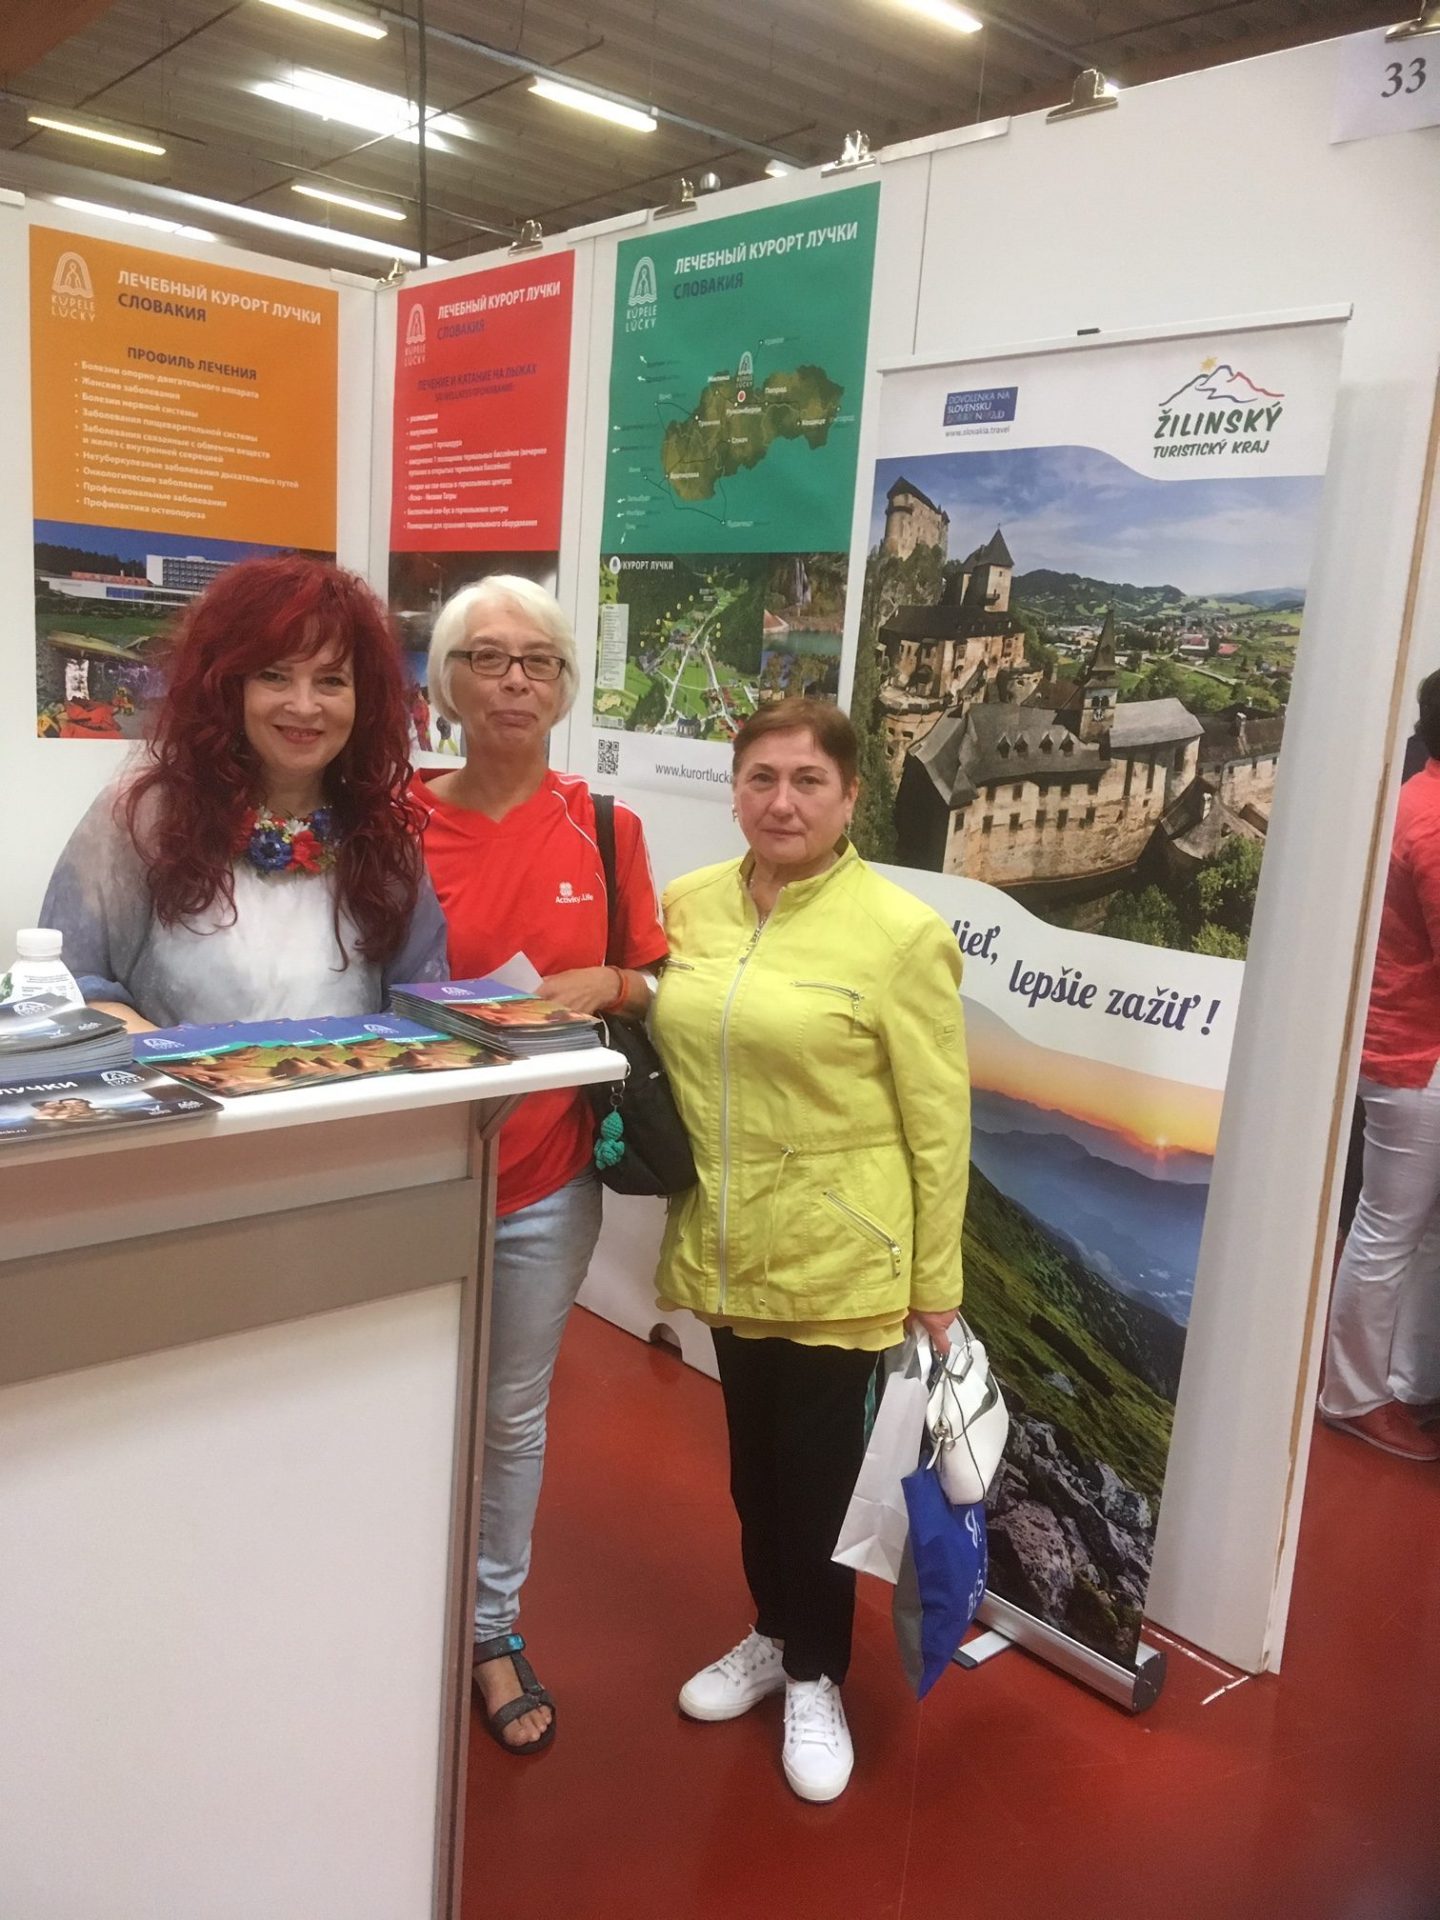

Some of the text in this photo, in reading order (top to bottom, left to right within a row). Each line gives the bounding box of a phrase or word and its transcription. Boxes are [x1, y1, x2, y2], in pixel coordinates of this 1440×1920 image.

[1381, 57, 1426, 98] 33
[674, 221, 859, 275] ЛЕЧЕБНЫЙ КУРОРТ ЛУЧКИ
[118, 270, 321, 326] ЛЕЧЕБНЫЙ КУРОРТ ЛУЧКИ
[437, 281, 561, 320] ЛЕЧЕБНЫЙ КУРОРТ ЛУЧКИ
[673, 272, 744, 300] СЛОВАКИЯ
[118, 292, 207, 322] СЛОВАКИЯ
[437, 319, 485, 341] СЛОВАКИЯ
[127, 347, 257, 380] ПРОФИЛЬ ЛЕЧЕНИЯ
[947, 402, 993, 414] SLOVENSKU
[948, 391, 1011, 405] DOVOLENKA NA
[1154, 401, 1283, 439] ŽILINSKÝ
[1153, 438, 1270, 459] TURISTICKÝ KRAJ
[622, 560, 674, 571] КУРОРТ ЛУЧКИ
[1008, 959, 1097, 1009] lepšie
[0, 1081, 79, 1096] ЛУЧКИ
